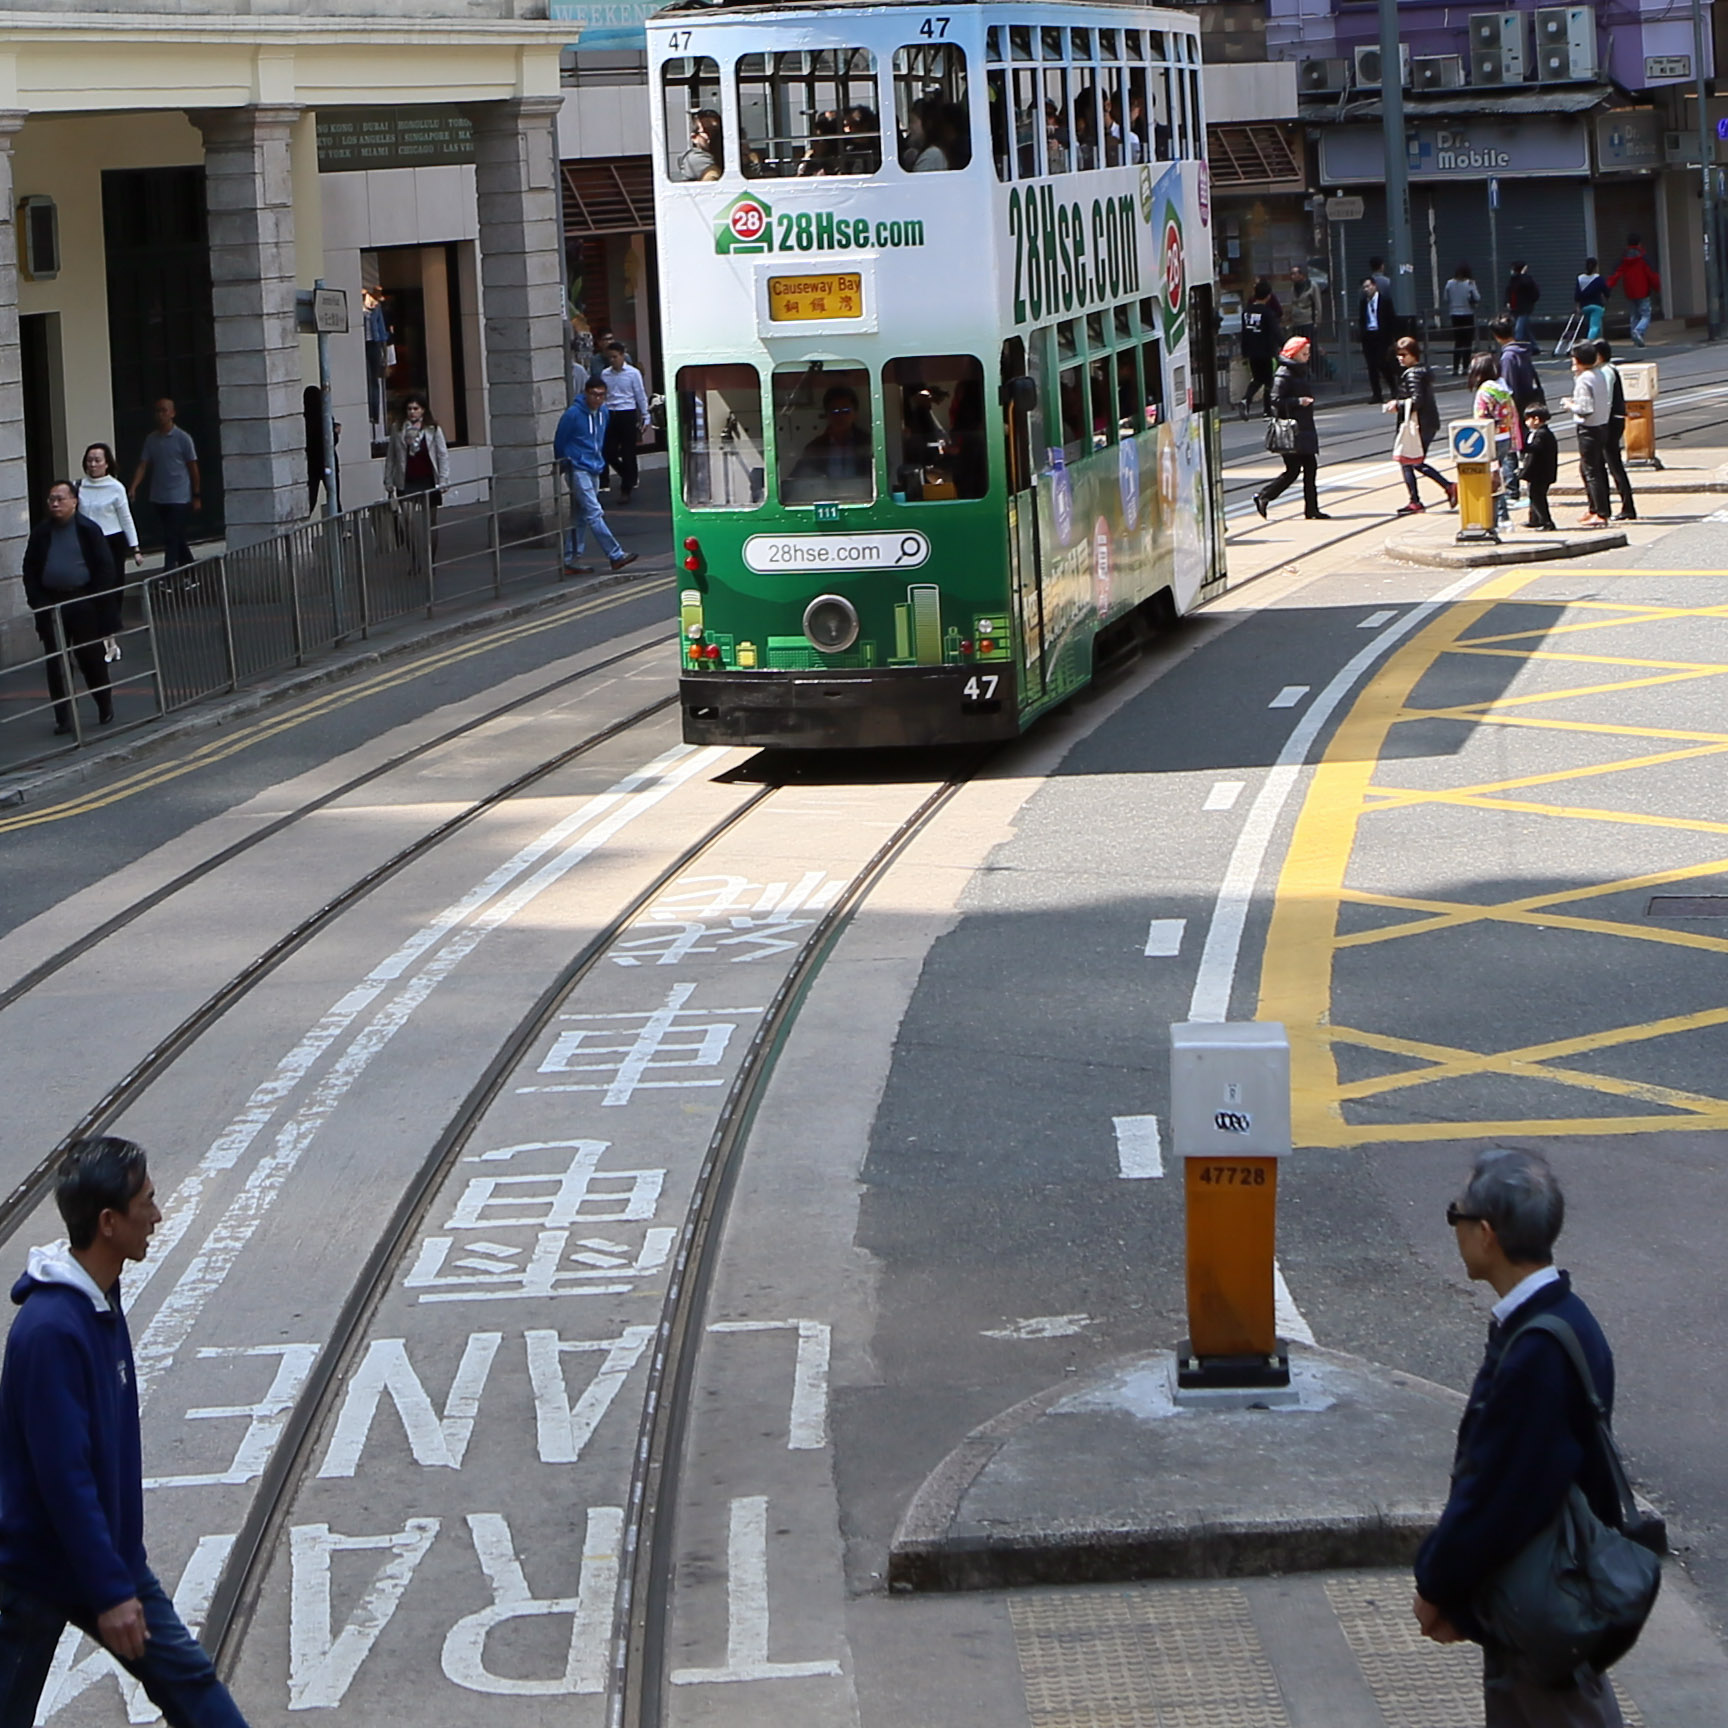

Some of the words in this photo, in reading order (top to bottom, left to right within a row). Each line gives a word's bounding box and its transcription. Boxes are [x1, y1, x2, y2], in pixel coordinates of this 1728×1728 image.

[920, 17, 950, 38] 47
[669, 31, 692, 51] 47
[331, 123, 353, 133] KONG
[362, 122, 389, 131] DUBAI
[397, 120, 440, 130] HONOLULU
[342, 136, 357, 145] LOS
[359, 134, 396, 144] ANGELES
[404, 132, 450, 142] SINGAPORE
[1437, 131, 1470, 148] Dr.
[329, 149, 351, 159] YORK
[361, 147, 389, 157] MIAMI
[398, 145, 434, 155] CHICAGO
[443, 143, 458, 153] LAS
[1438, 149, 1509, 169] Mobile
[735, 211, 760, 231] 28
[777, 212, 925, 251] 28Hse.com
[1009, 184, 1140, 325] 28Hse.com
[1167, 242, 1180, 292] 28
[773, 280, 834, 297] Causeway
[838, 276, 861, 294] Bay
[784, 296, 853, 314] 銅鑼灣
[817, 506, 836, 518] 111
[768, 543, 880, 563] 28hse.com
[963, 675, 999, 700] 47
[1198, 1166, 1266, 1187] 47728
[143, 1319, 832, 1488] LANE
